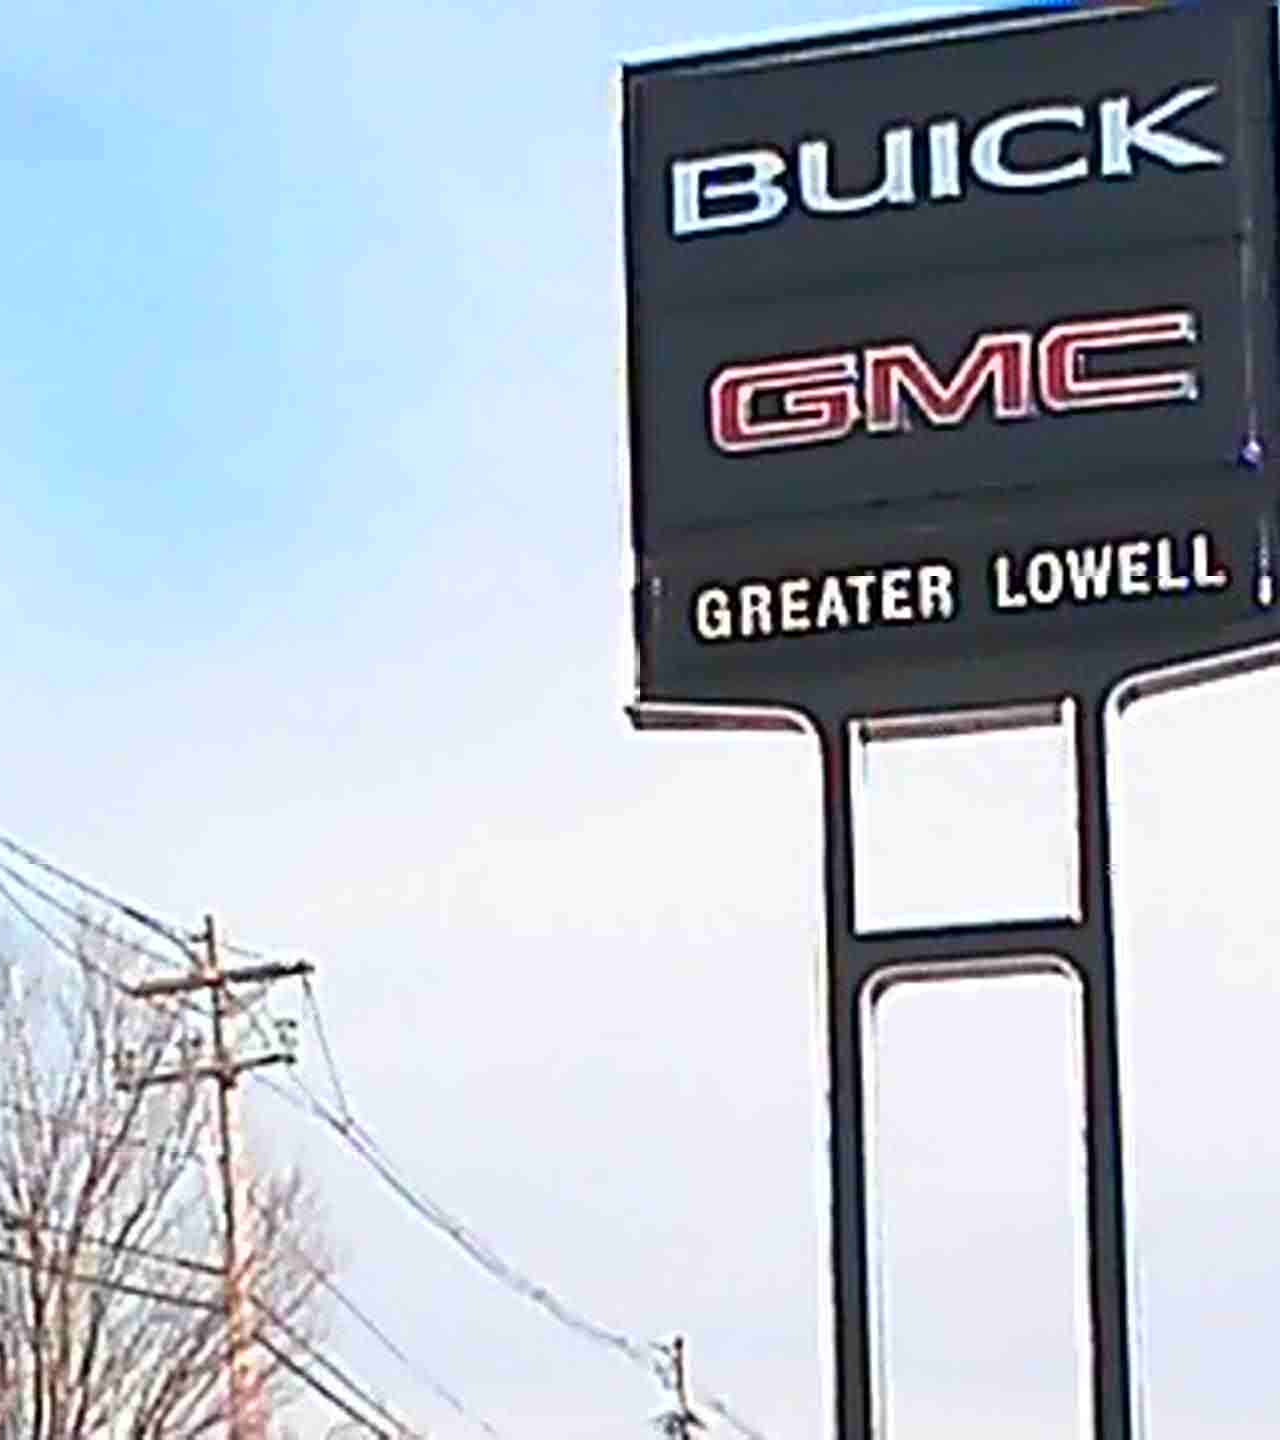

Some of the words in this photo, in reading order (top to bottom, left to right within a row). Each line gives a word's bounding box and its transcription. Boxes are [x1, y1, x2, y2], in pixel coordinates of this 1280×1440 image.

[670, 83, 1225, 237] BUICK
[709, 311, 1197, 452] GMC
[695, 566, 954, 640] GREATER
[995, 533, 1228, 609] LOWELL
